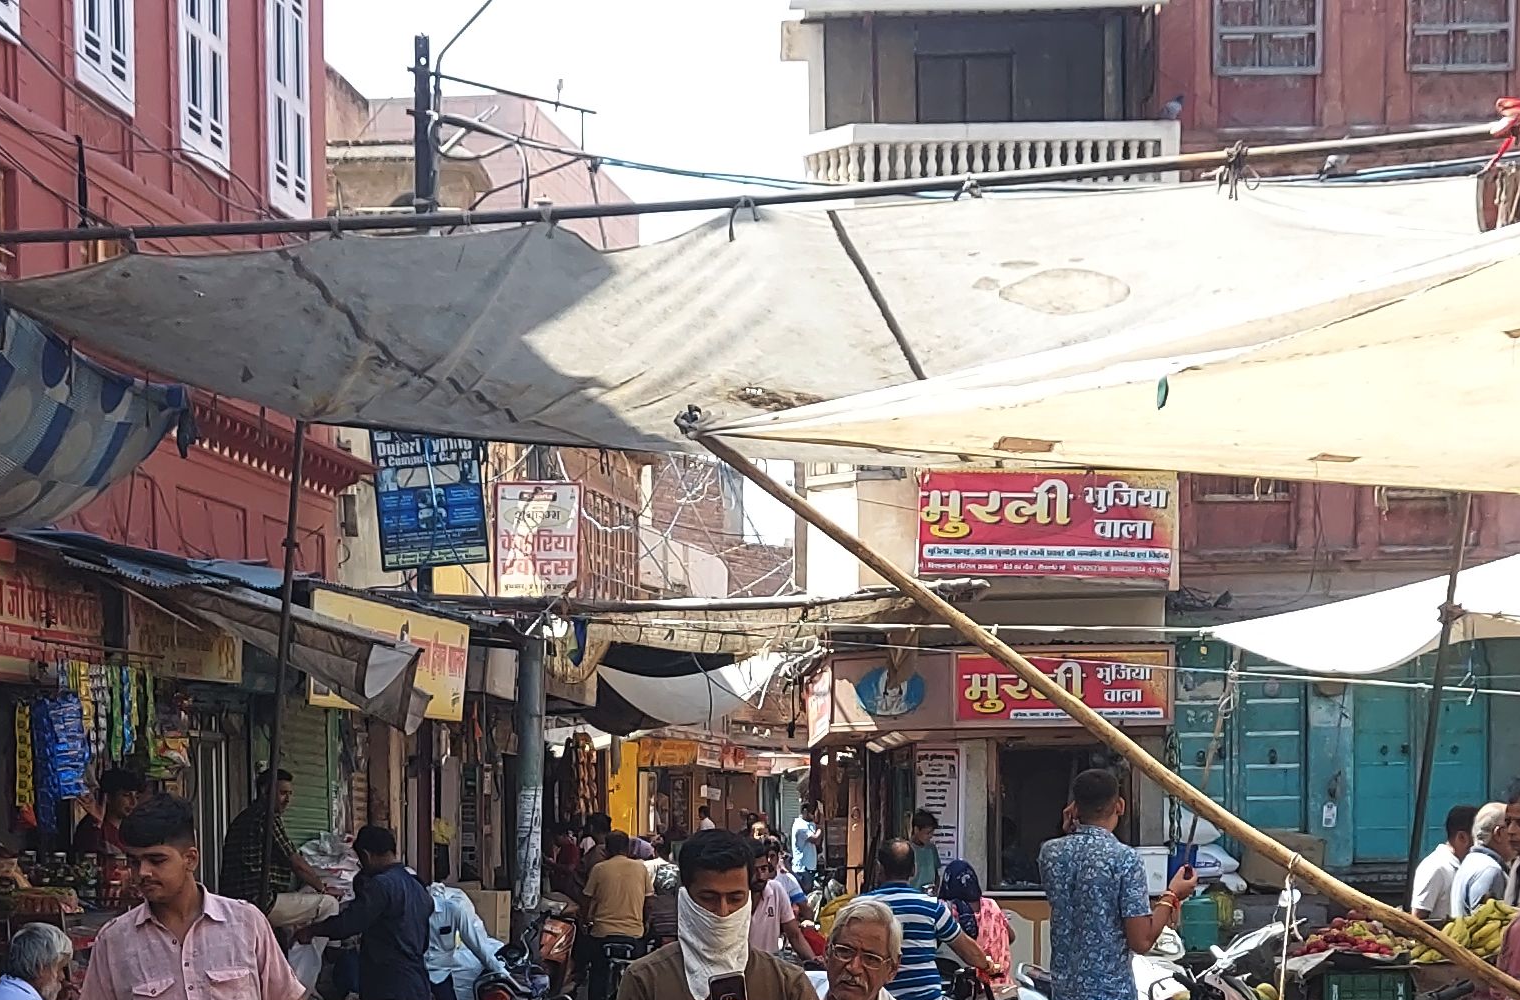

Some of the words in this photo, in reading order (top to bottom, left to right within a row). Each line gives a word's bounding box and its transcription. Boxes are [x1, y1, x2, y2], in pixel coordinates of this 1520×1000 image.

[1083, 479, 1170, 515] भुजिया
[920, 479, 1075, 539] मुरली
[1093, 518, 1154, 541] वाला
[1095, 664, 1153, 685] भुजिया
[1103, 688, 1145, 704] वाला
